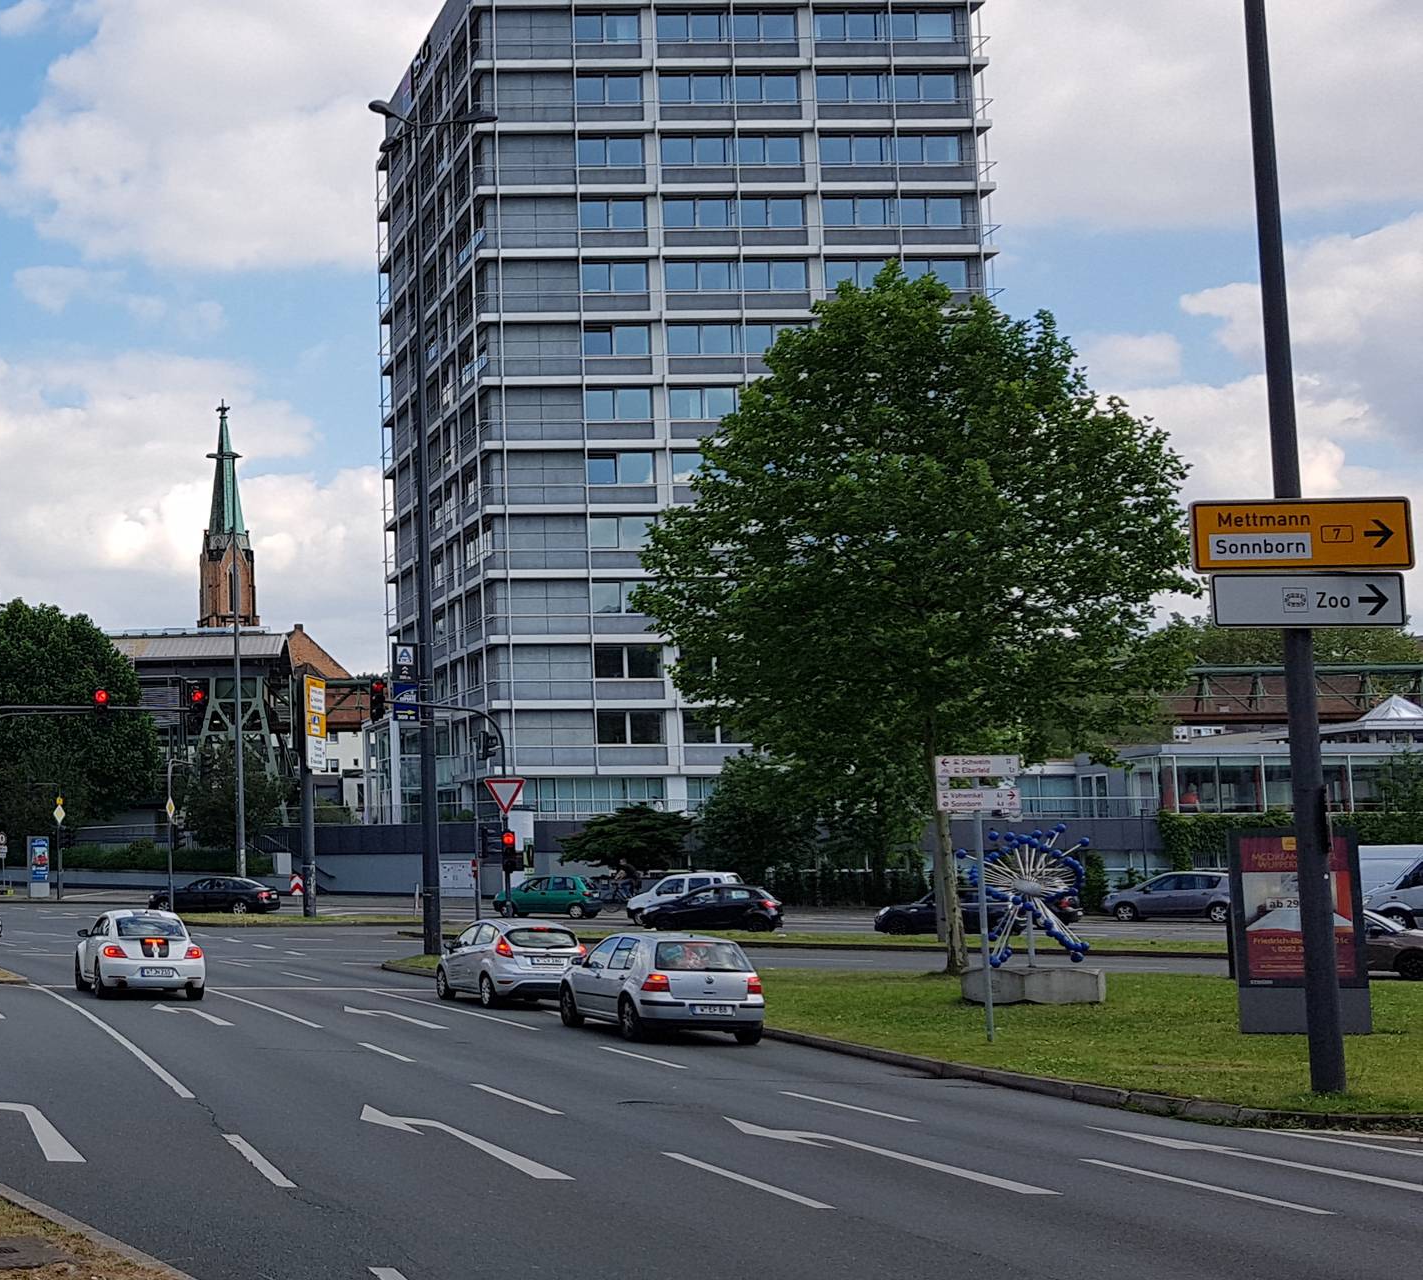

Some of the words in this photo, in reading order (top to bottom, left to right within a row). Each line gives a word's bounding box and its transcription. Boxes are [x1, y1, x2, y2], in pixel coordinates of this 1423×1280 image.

[1217, 511, 1311, 528] Mettmann
[1332, 528, 1341, 540] 7
[1215, 539, 1306, 555] Sonnborn
[1315, 591, 1351, 609] Zoo
[1269, 899, 1283, 908] ab
